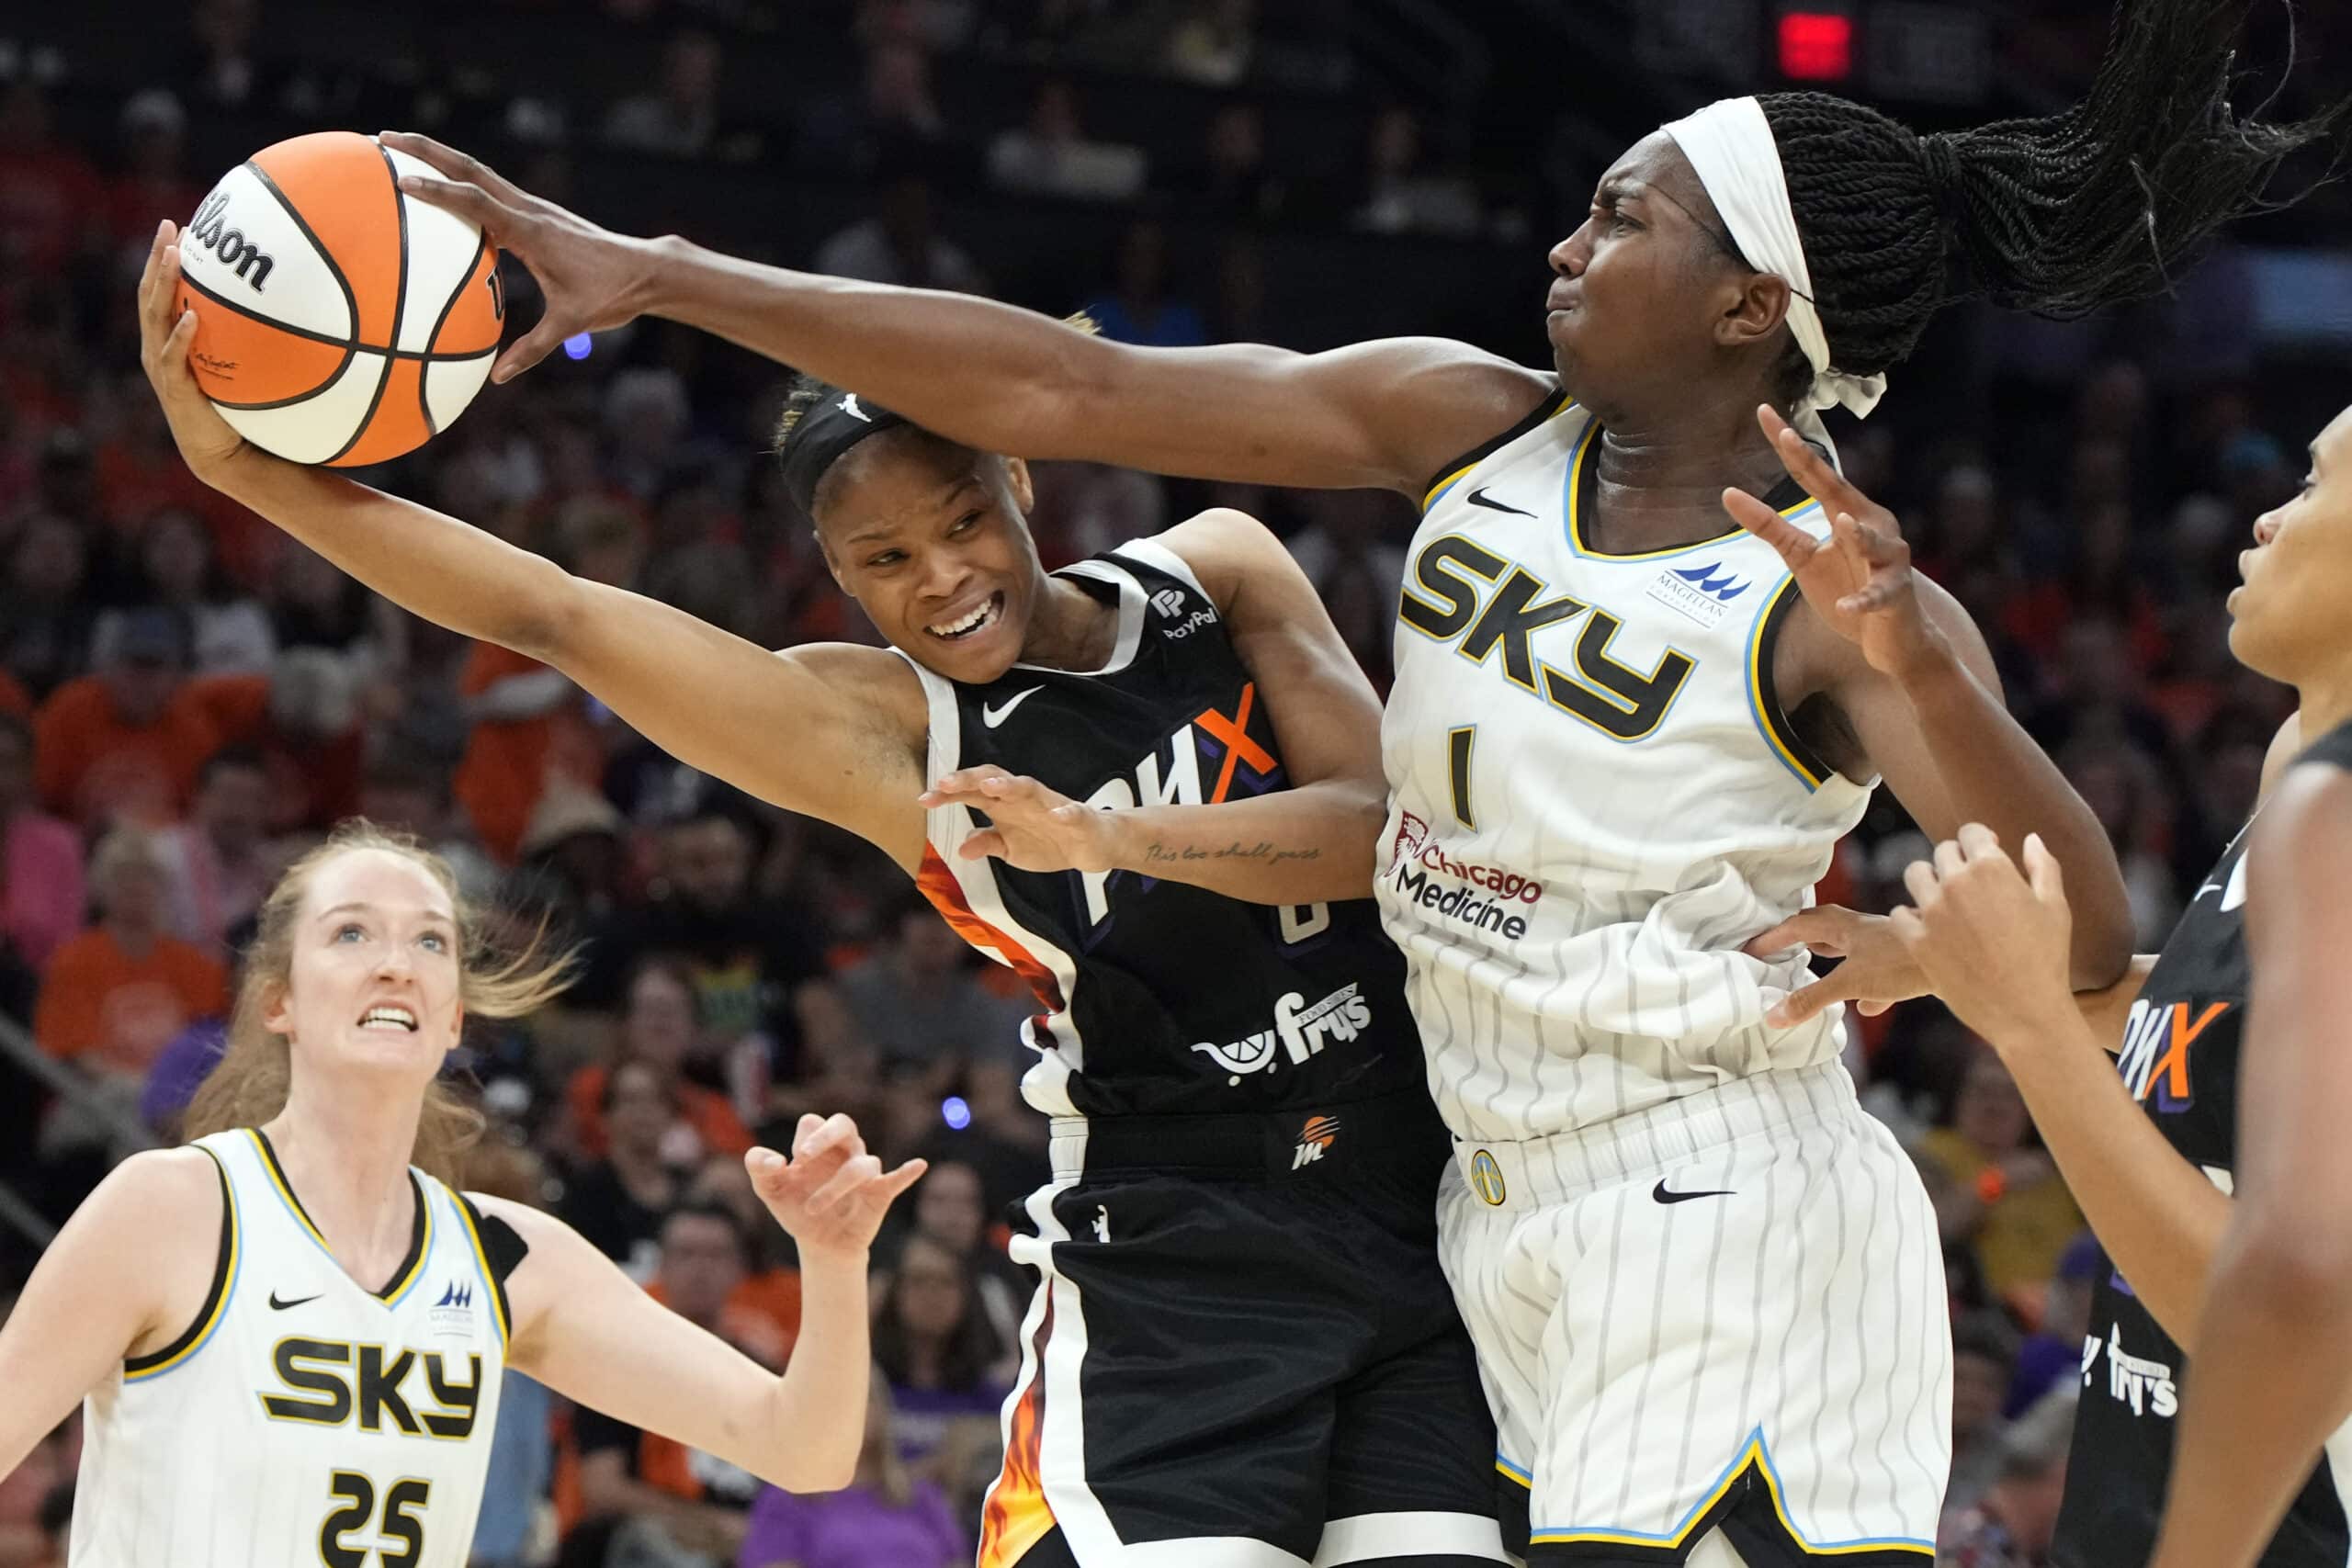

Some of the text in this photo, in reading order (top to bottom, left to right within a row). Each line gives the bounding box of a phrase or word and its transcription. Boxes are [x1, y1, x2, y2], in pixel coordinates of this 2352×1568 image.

[190, 190, 276, 295] ilson
[1162, 607, 1217, 640] PayPal
[1398, 532, 1700, 744] SKY
[1657, 574, 1724, 618] MAGELLAN
[1448, 723, 1478, 833] 1
[1147, 841, 1323, 865] This too shall pass
[1421, 843, 1543, 905] Chicago
[1396, 863, 1527, 941] Medicine
[256, 1335, 483, 1442] SKY
[316, 1469, 434, 1568] 25
